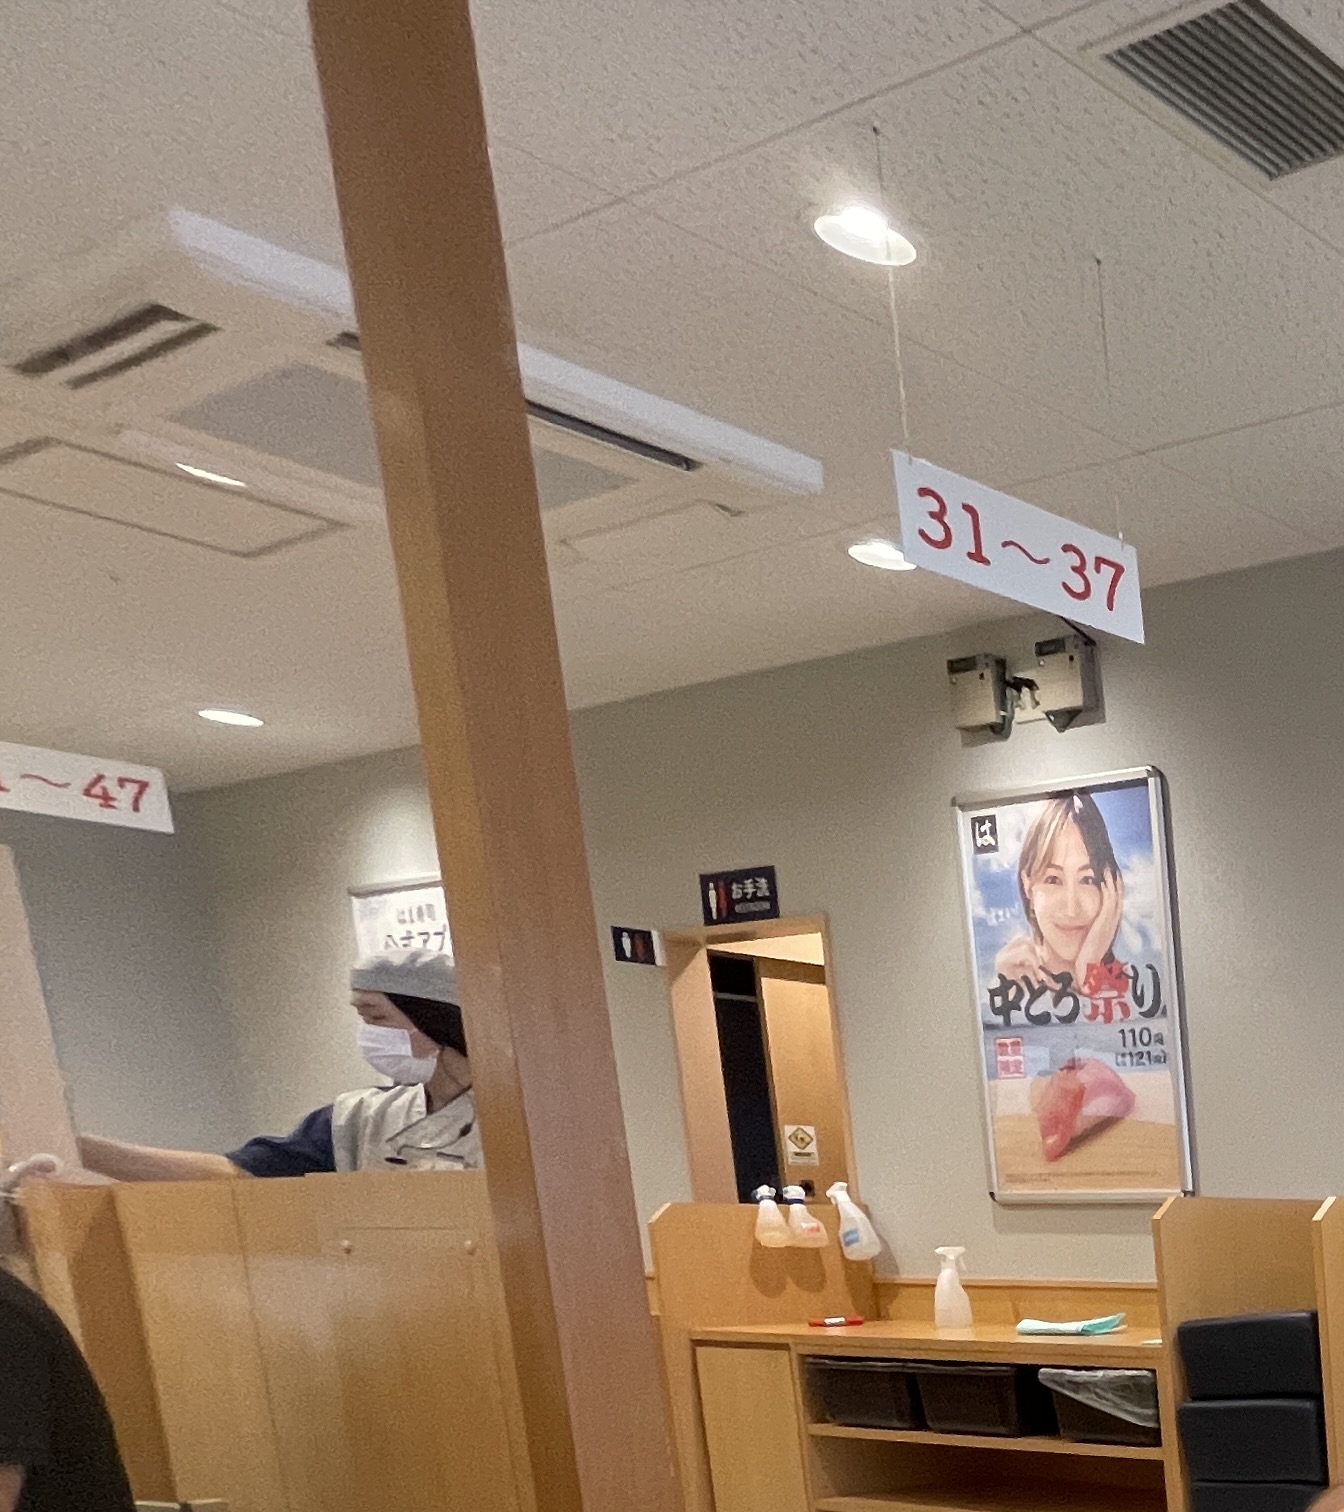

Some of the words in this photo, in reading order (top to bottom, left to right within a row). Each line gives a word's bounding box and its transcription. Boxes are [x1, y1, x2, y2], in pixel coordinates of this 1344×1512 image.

[0, 772, 150, 813] ～47
[973, 818, 997, 848] は
[986, 954, 1163, 1027] 中とろ祭り
